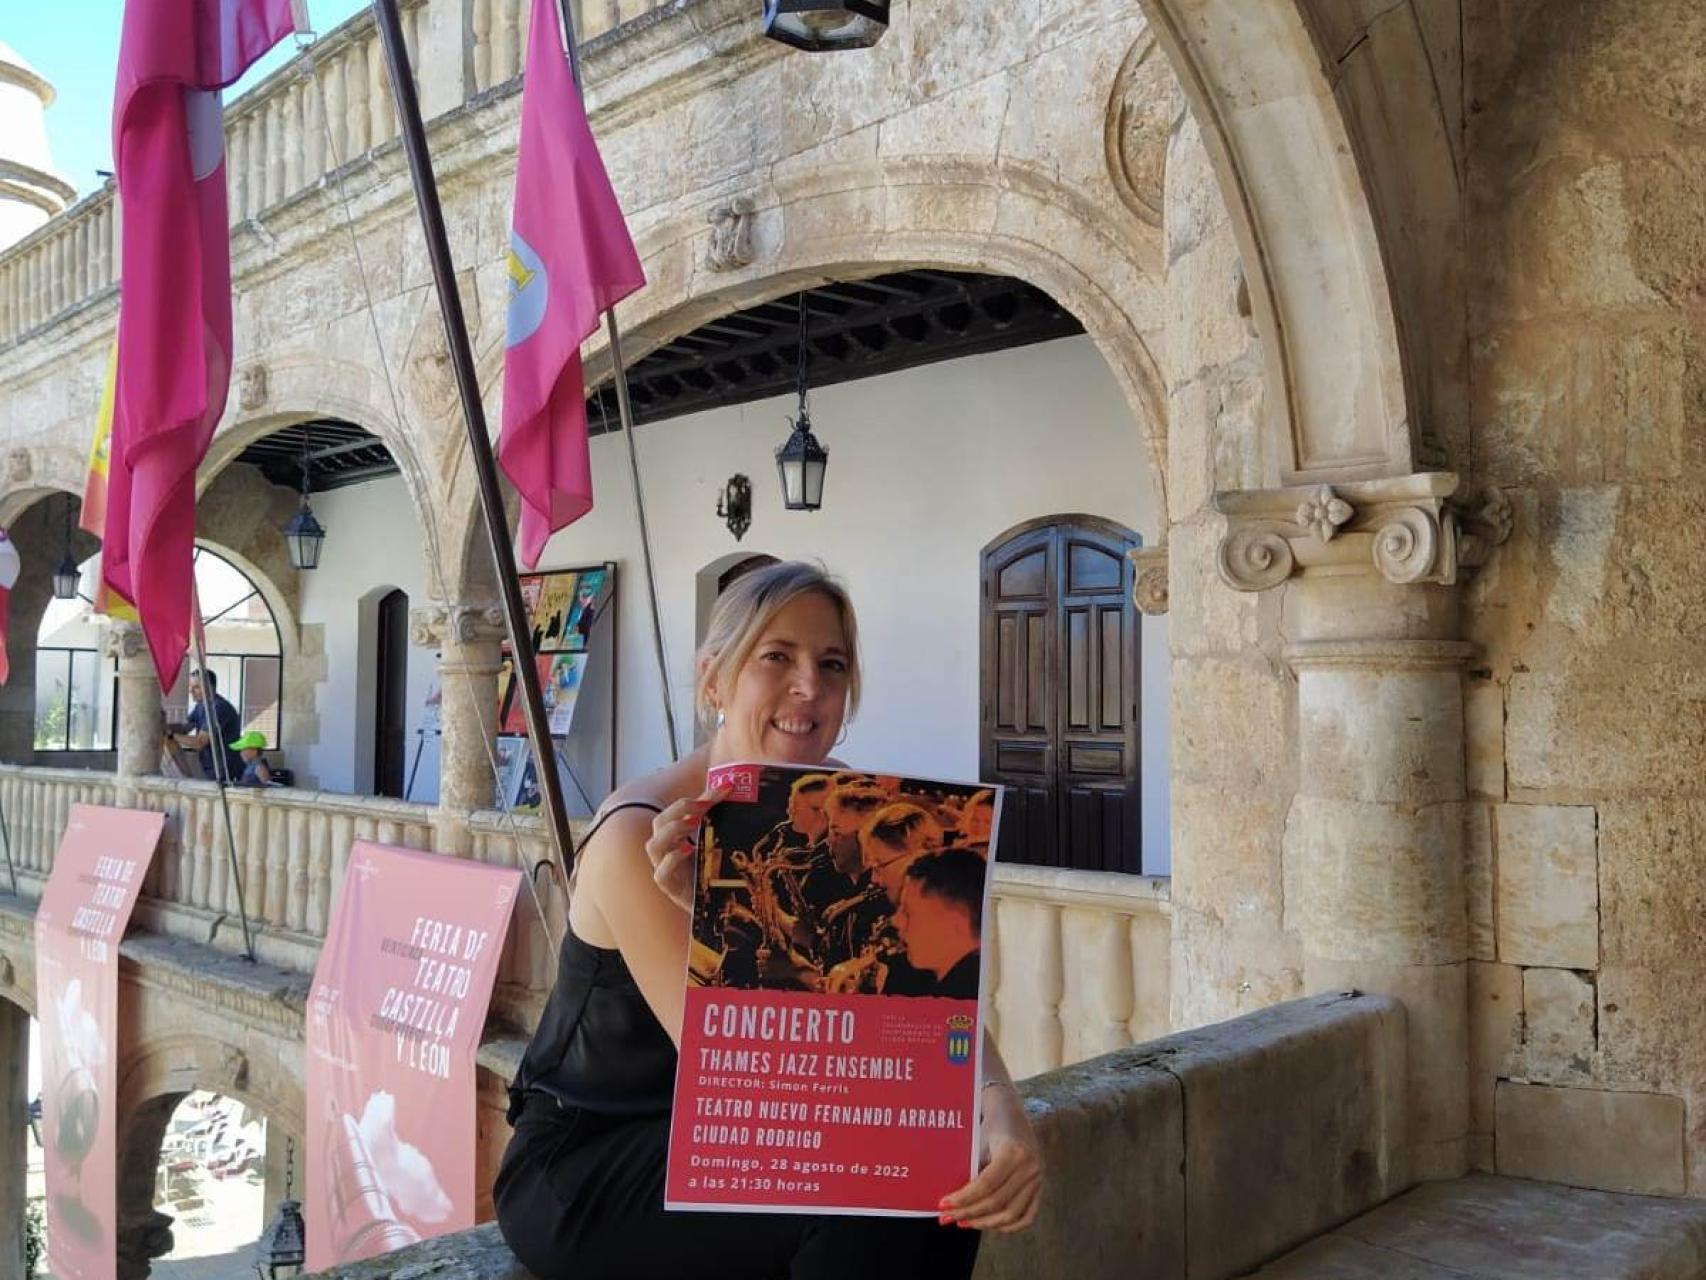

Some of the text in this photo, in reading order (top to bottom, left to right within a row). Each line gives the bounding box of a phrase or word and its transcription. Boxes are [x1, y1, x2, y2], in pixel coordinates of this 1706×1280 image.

[410, 917, 462, 957] FERIA
[414, 957, 471, 999] TEATRO
[380, 987, 460, 1037] CASTILLA
[703, 1003, 856, 1045] CONCIERTO
[700, 1048, 914, 1081] THAMES JAZZ ENSEMBLE
[698, 1076, 850, 1095] DIRECTOR: Simon Ferris
[695, 1097, 965, 1129] TEATRO NUEVO FERNANDO ARRABAL
[693, 1125, 822, 1149] CIUDAD RODRIGO
[690, 1155, 910, 1178] Domingo, 28 agosto de 2022
[687, 1176, 820, 1192] a las 21:30 horas
